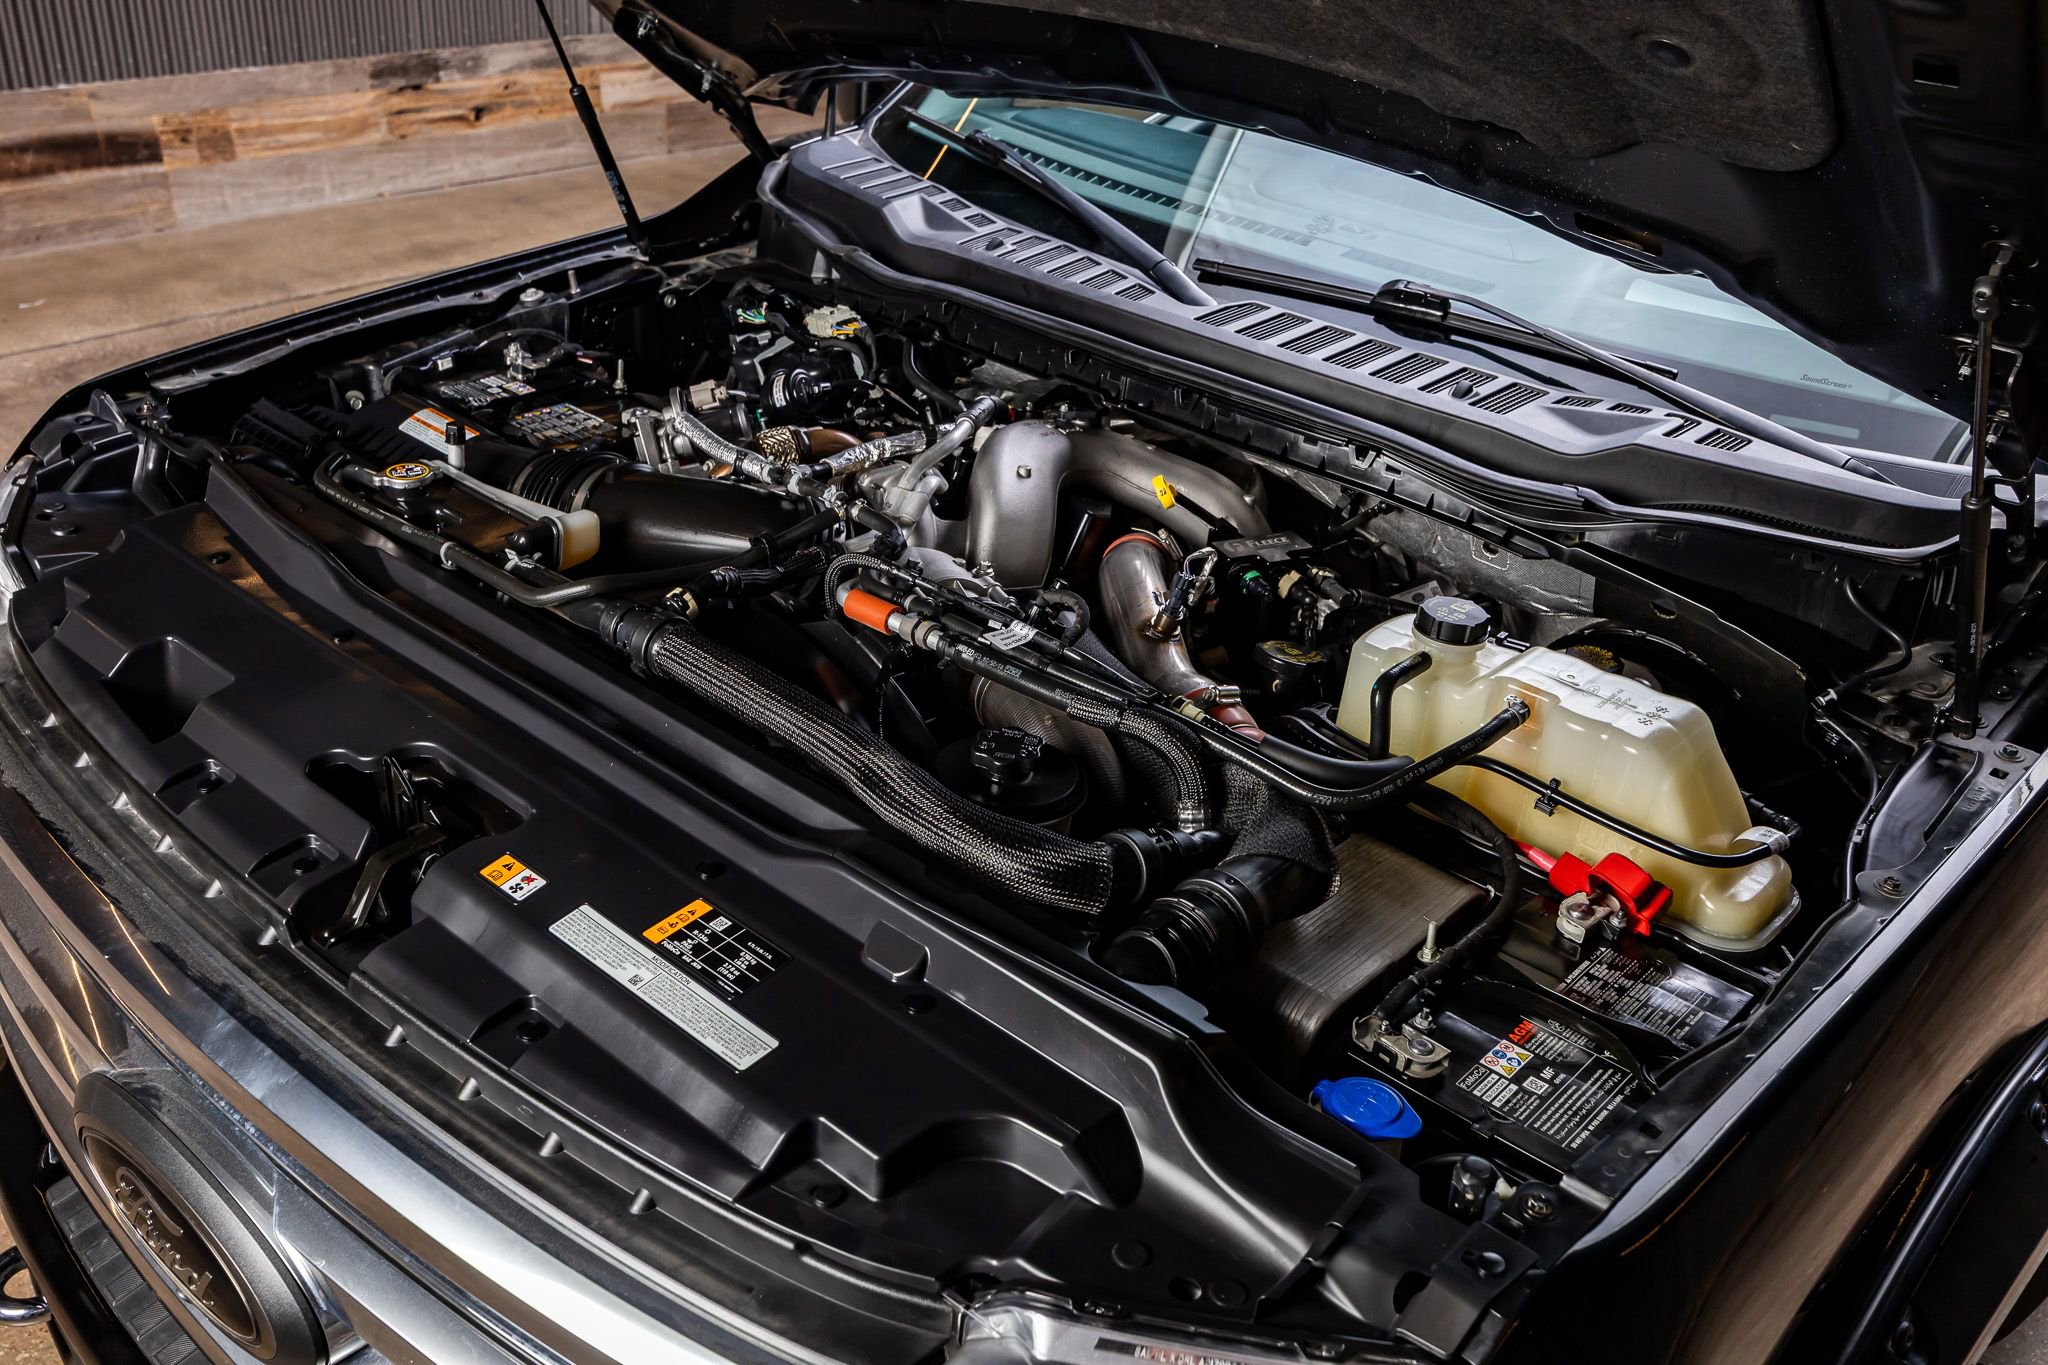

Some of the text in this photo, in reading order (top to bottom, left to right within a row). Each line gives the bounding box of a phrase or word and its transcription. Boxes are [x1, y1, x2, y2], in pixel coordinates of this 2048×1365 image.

[1245, 536, 1290, 548] FLEECE
[651, 955, 691, 985] MODIFICATION
[1508, 1020, 1534, 1043] AGM
[1460, 1066, 1486, 1090] FoMoCo
[1539, 1066, 1556, 1080] MF
